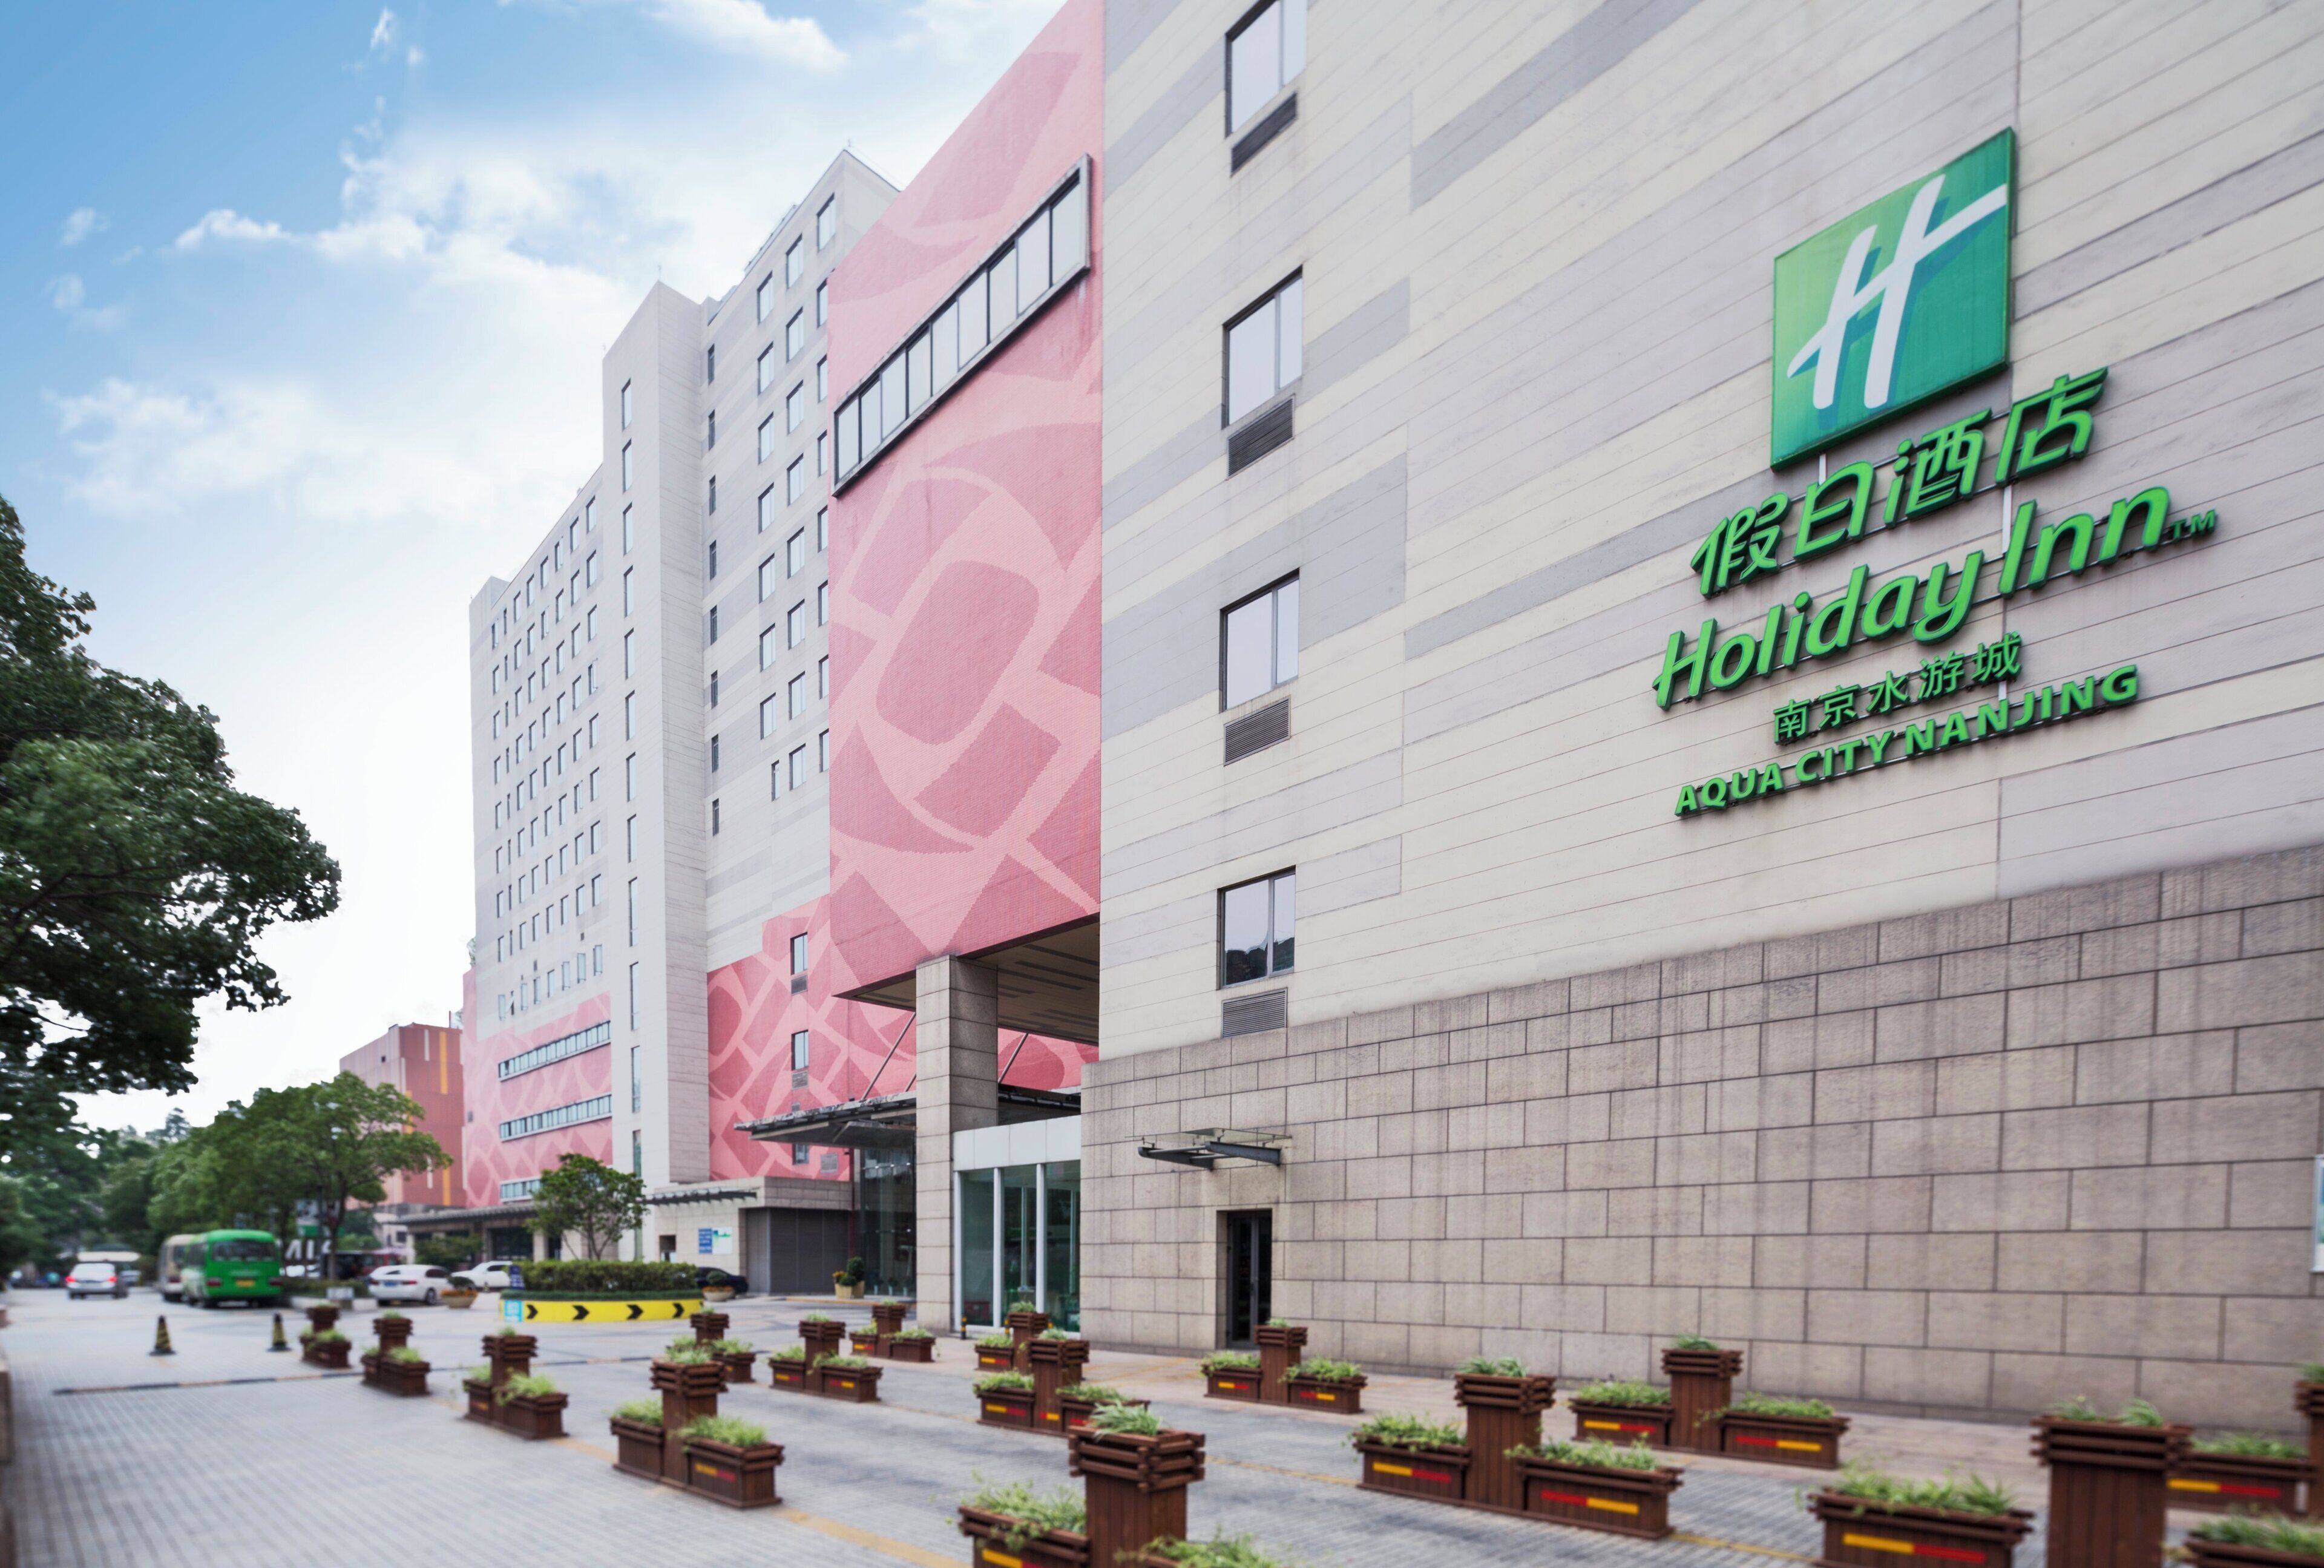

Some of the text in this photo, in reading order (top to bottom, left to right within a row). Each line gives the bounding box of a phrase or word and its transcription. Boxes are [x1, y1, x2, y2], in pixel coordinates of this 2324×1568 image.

[1690, 366, 2109, 598] 假日酒店
[1652, 549, 1984, 710] Holiday
[1998, 486, 2171, 599] Inn
[1773, 631, 2023, 745] 南京水游城
[1674, 664, 2138, 816] AQUA CITY NANJING
